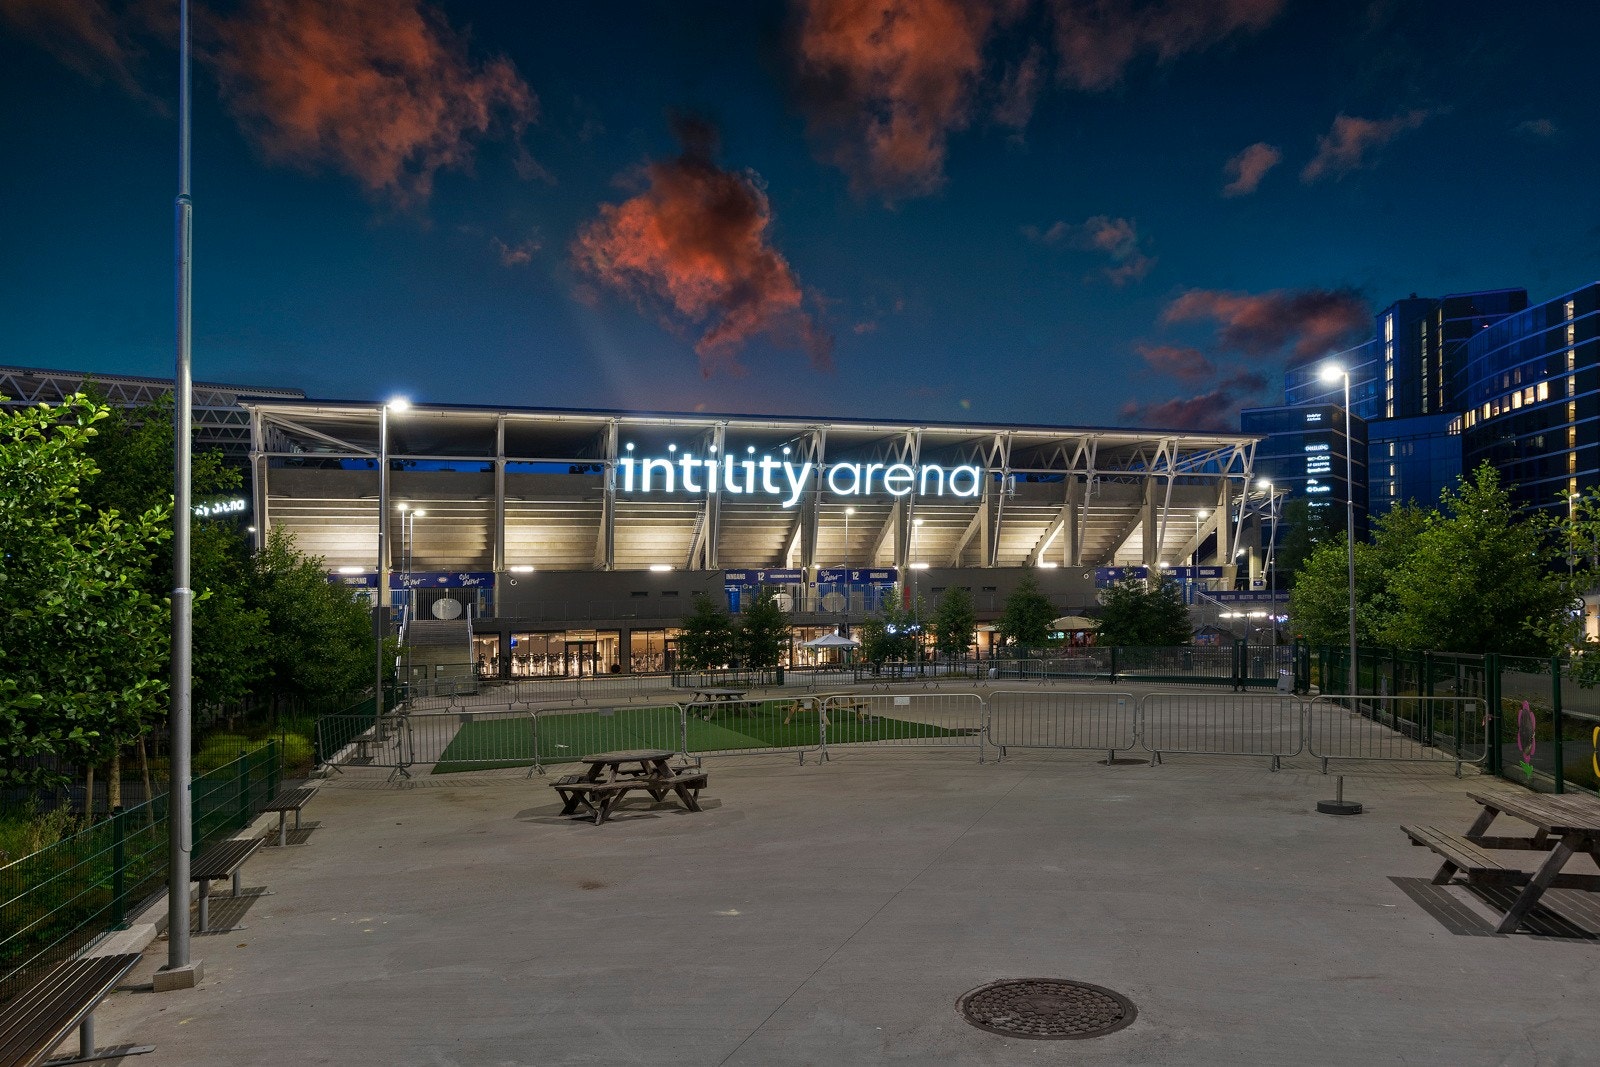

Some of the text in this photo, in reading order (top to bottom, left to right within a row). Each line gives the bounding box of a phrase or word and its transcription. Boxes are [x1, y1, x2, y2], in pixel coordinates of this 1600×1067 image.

[619, 442, 981, 508] intility arena
[757, 572, 765, 581] 12
[852, 571, 859, 581] 12
